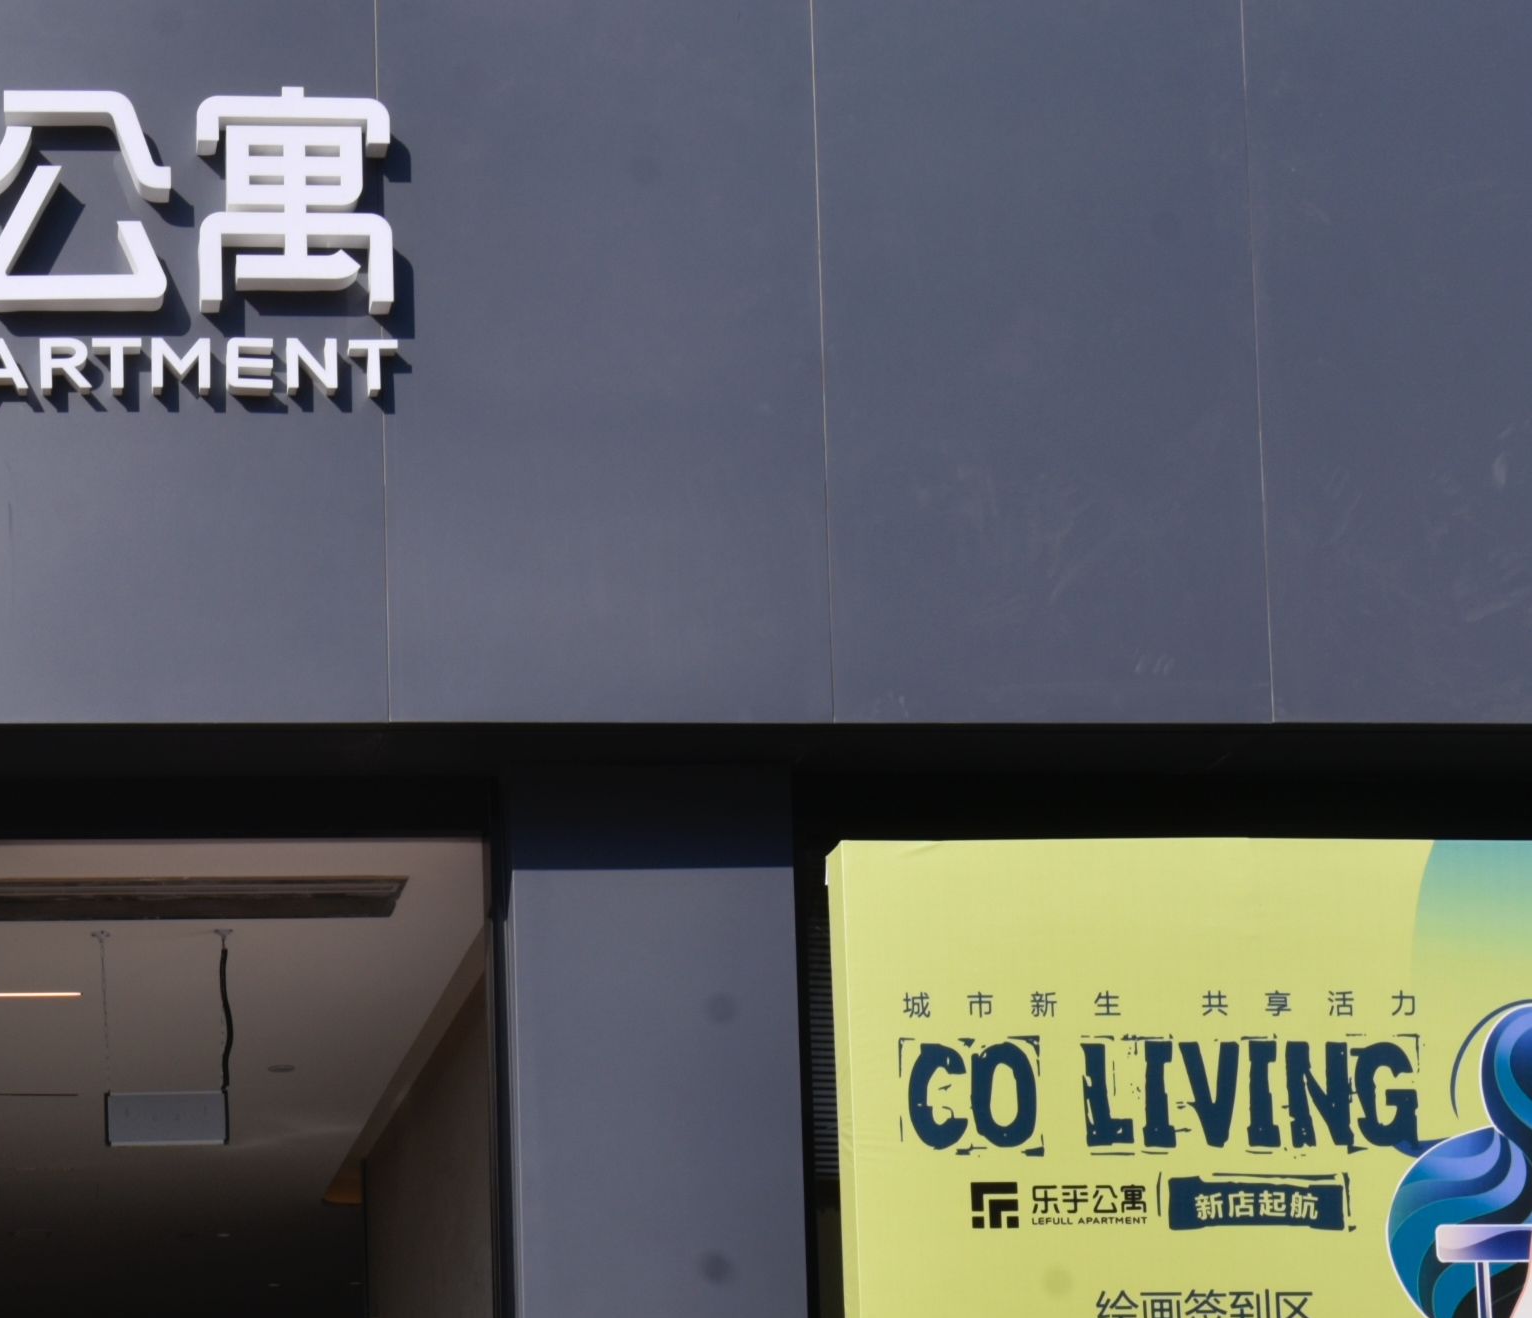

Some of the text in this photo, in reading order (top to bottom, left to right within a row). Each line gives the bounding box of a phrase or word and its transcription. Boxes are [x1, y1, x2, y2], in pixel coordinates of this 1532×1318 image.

[903, 990, 1416, 1018] 城市新生 共享活力
[908, 1041, 1419, 1149] CO LIVING
[1032, 1184, 1147, 1214] 乐乎公寓
[1194, 1190, 1319, 1220] 新店起航
[1031, 1216, 1148, 1226] LEFULL APARTMENT
